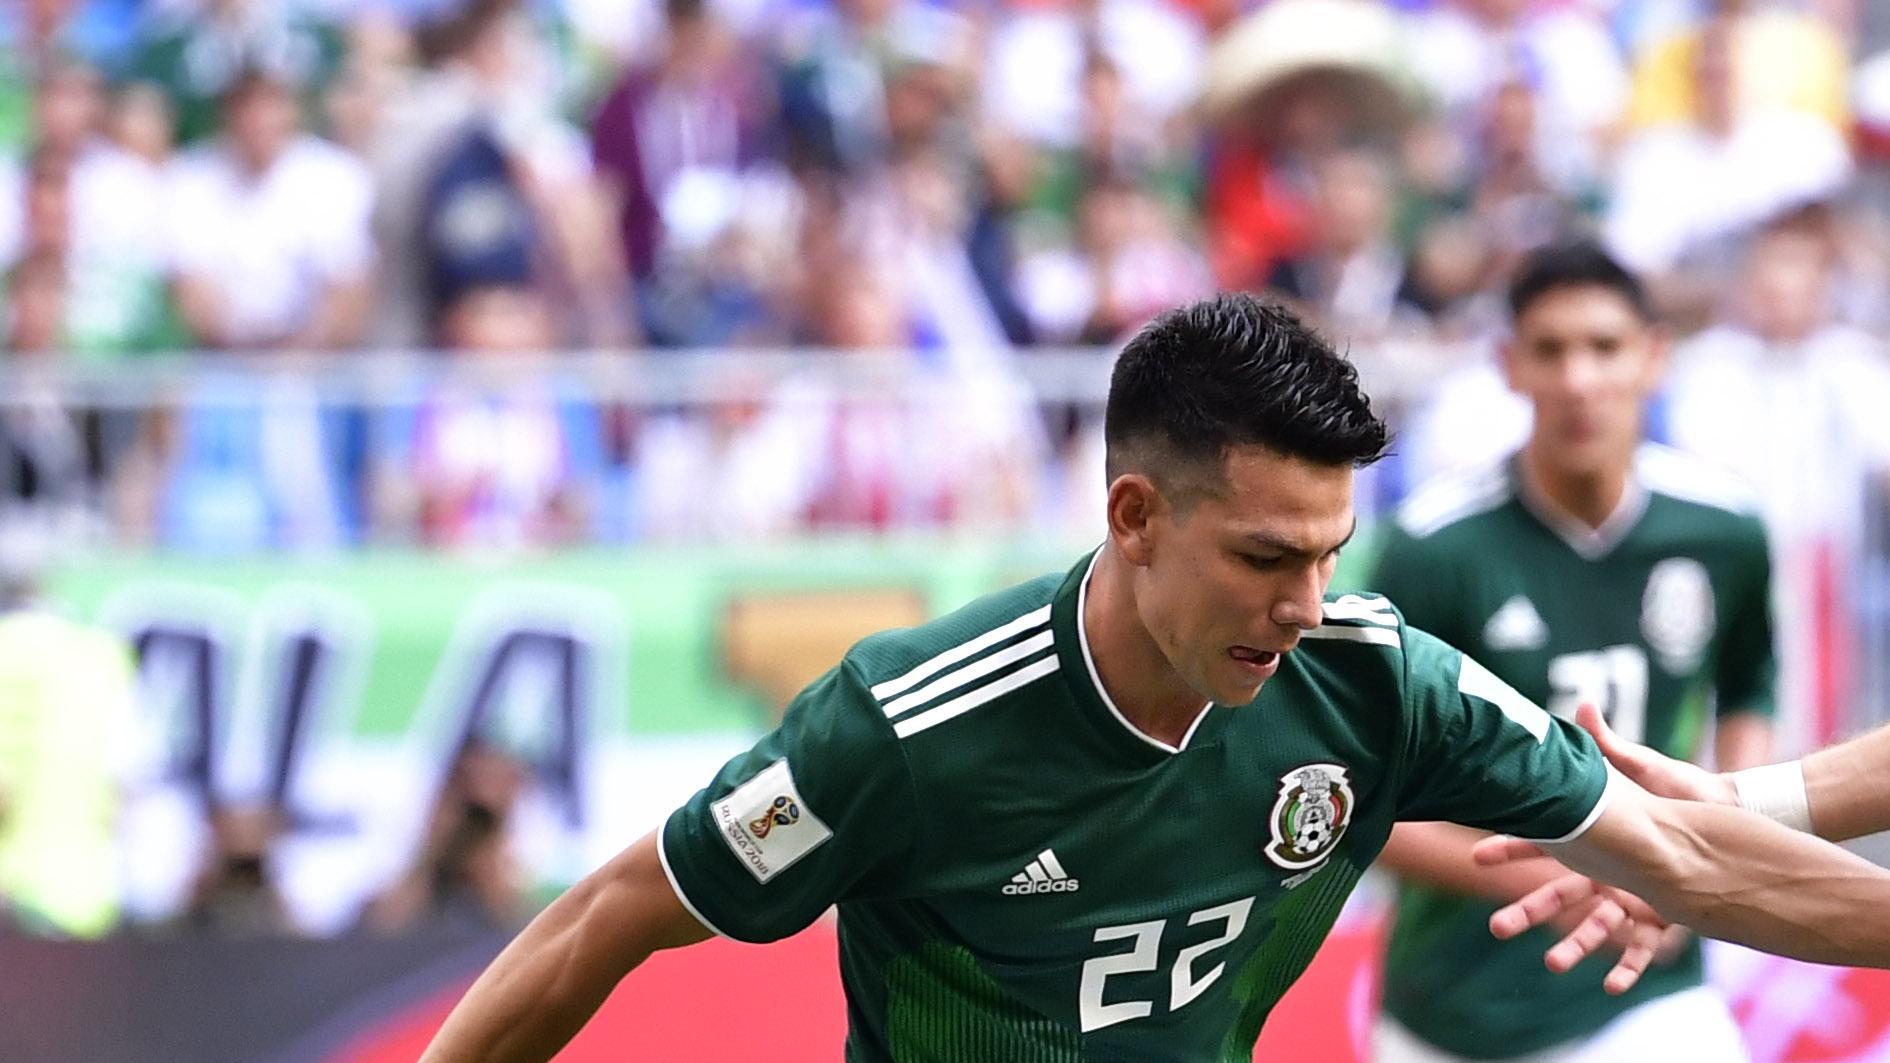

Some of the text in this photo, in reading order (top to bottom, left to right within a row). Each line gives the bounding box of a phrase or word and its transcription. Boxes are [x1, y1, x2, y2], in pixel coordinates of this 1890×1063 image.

[721, 804, 748, 850] RUSSIA
[745, 847, 769, 875] 2018
[1001, 879, 1080, 896] adidas
[1080, 896, 1256, 1033] 22
